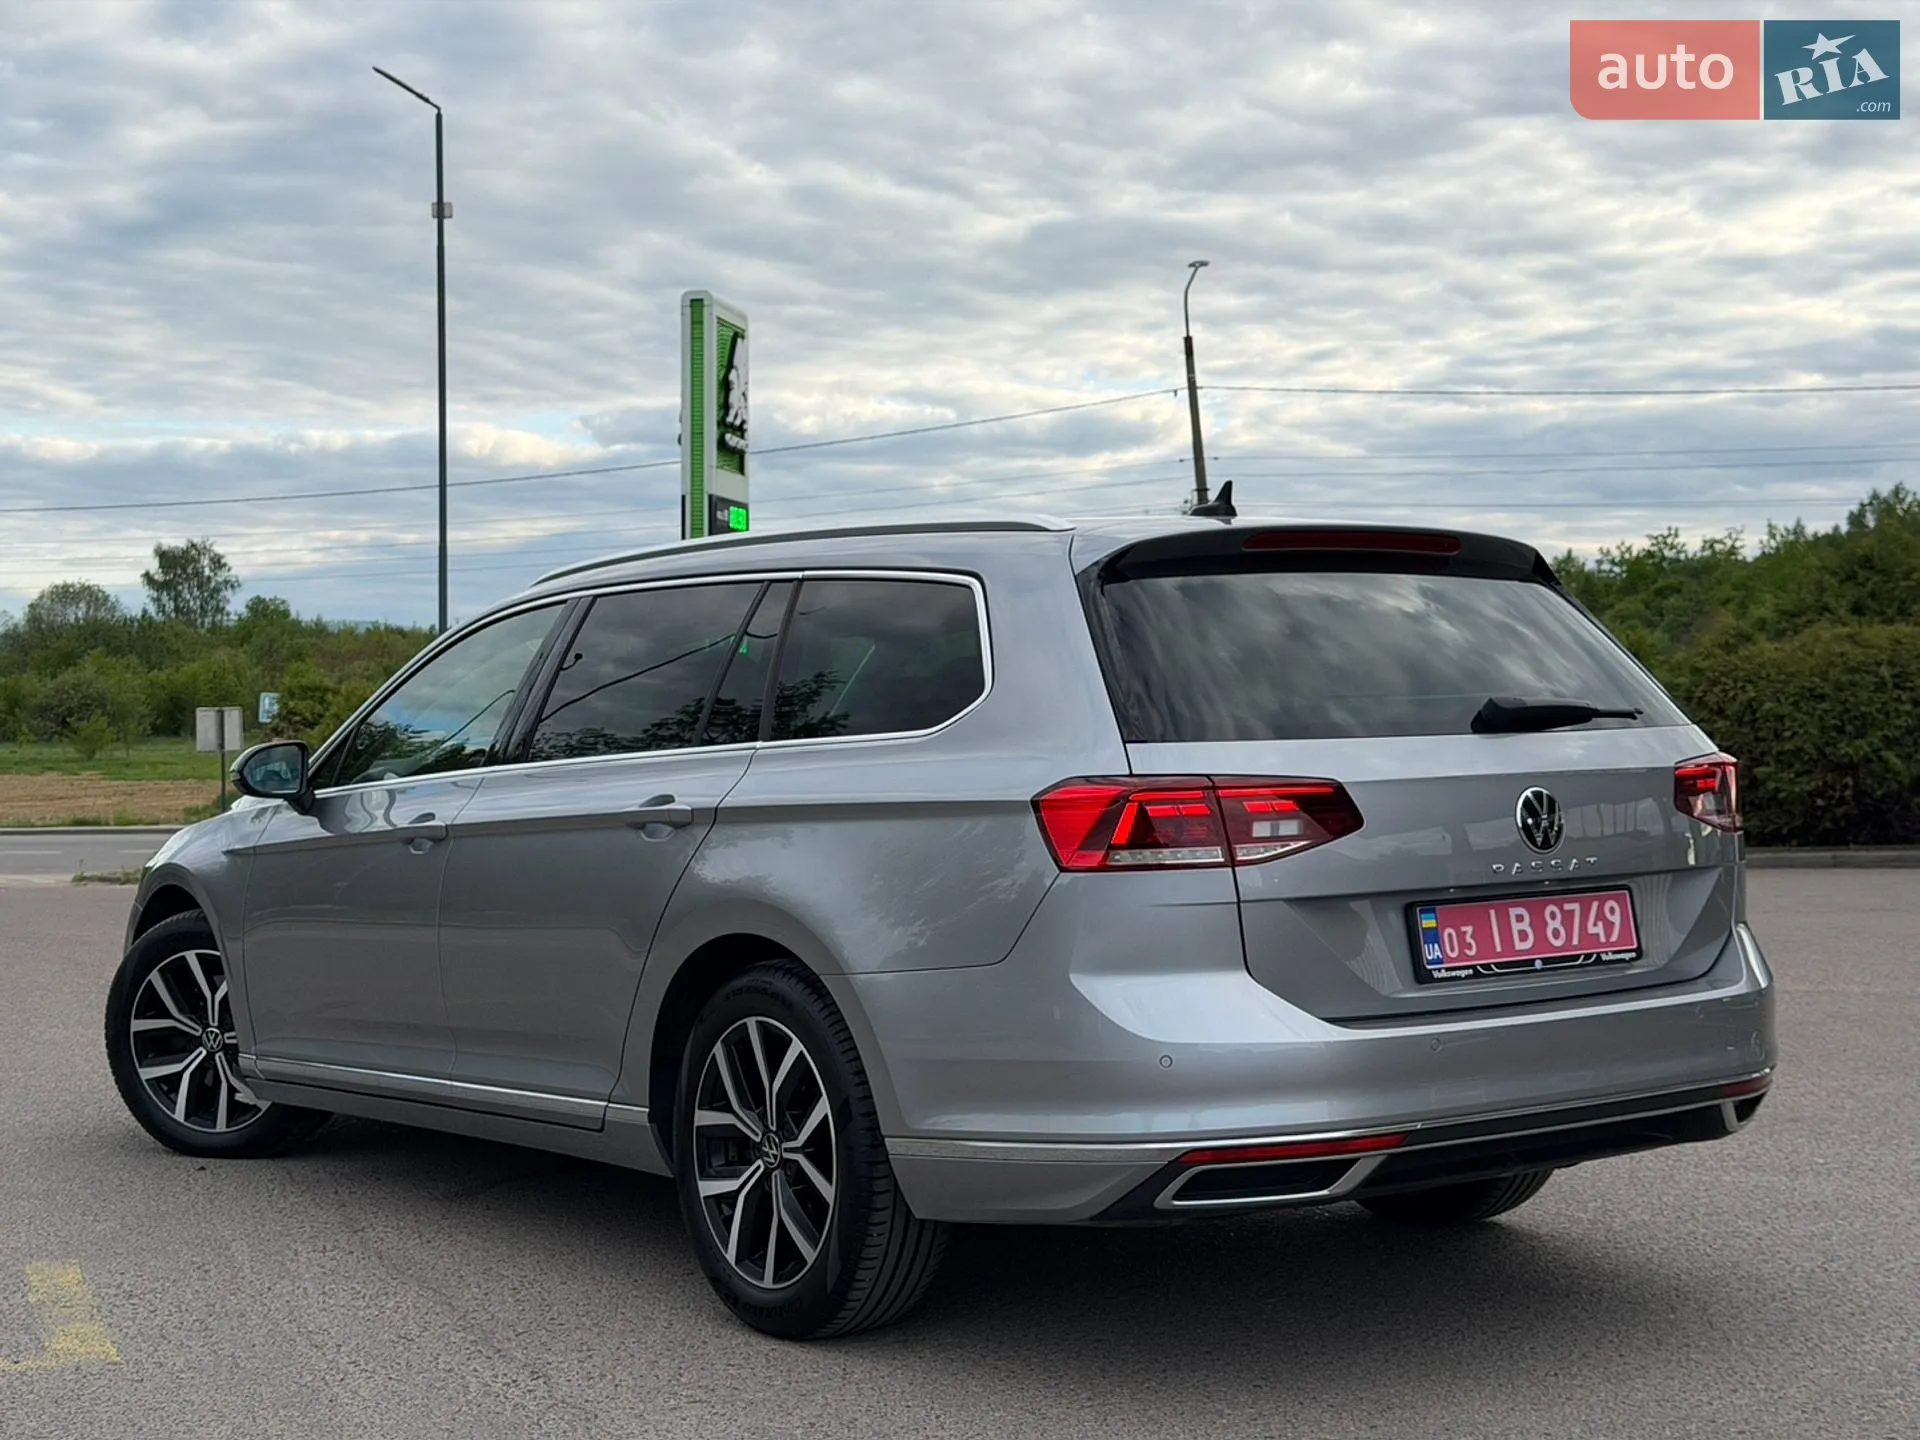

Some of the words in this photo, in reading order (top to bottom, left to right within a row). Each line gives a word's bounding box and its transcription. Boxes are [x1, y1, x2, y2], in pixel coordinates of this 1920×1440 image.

[1492, 856, 1598, 875] PASSAT
[1425, 942, 1443, 961] UA
[1443, 925, 1477, 959] 03
[1489, 906, 1535, 953] IB
[1544, 899, 1622, 948] 8749
[1600, 950, 1637, 962] Volkswagen
[1431, 967, 1474, 980] Volkswagen
